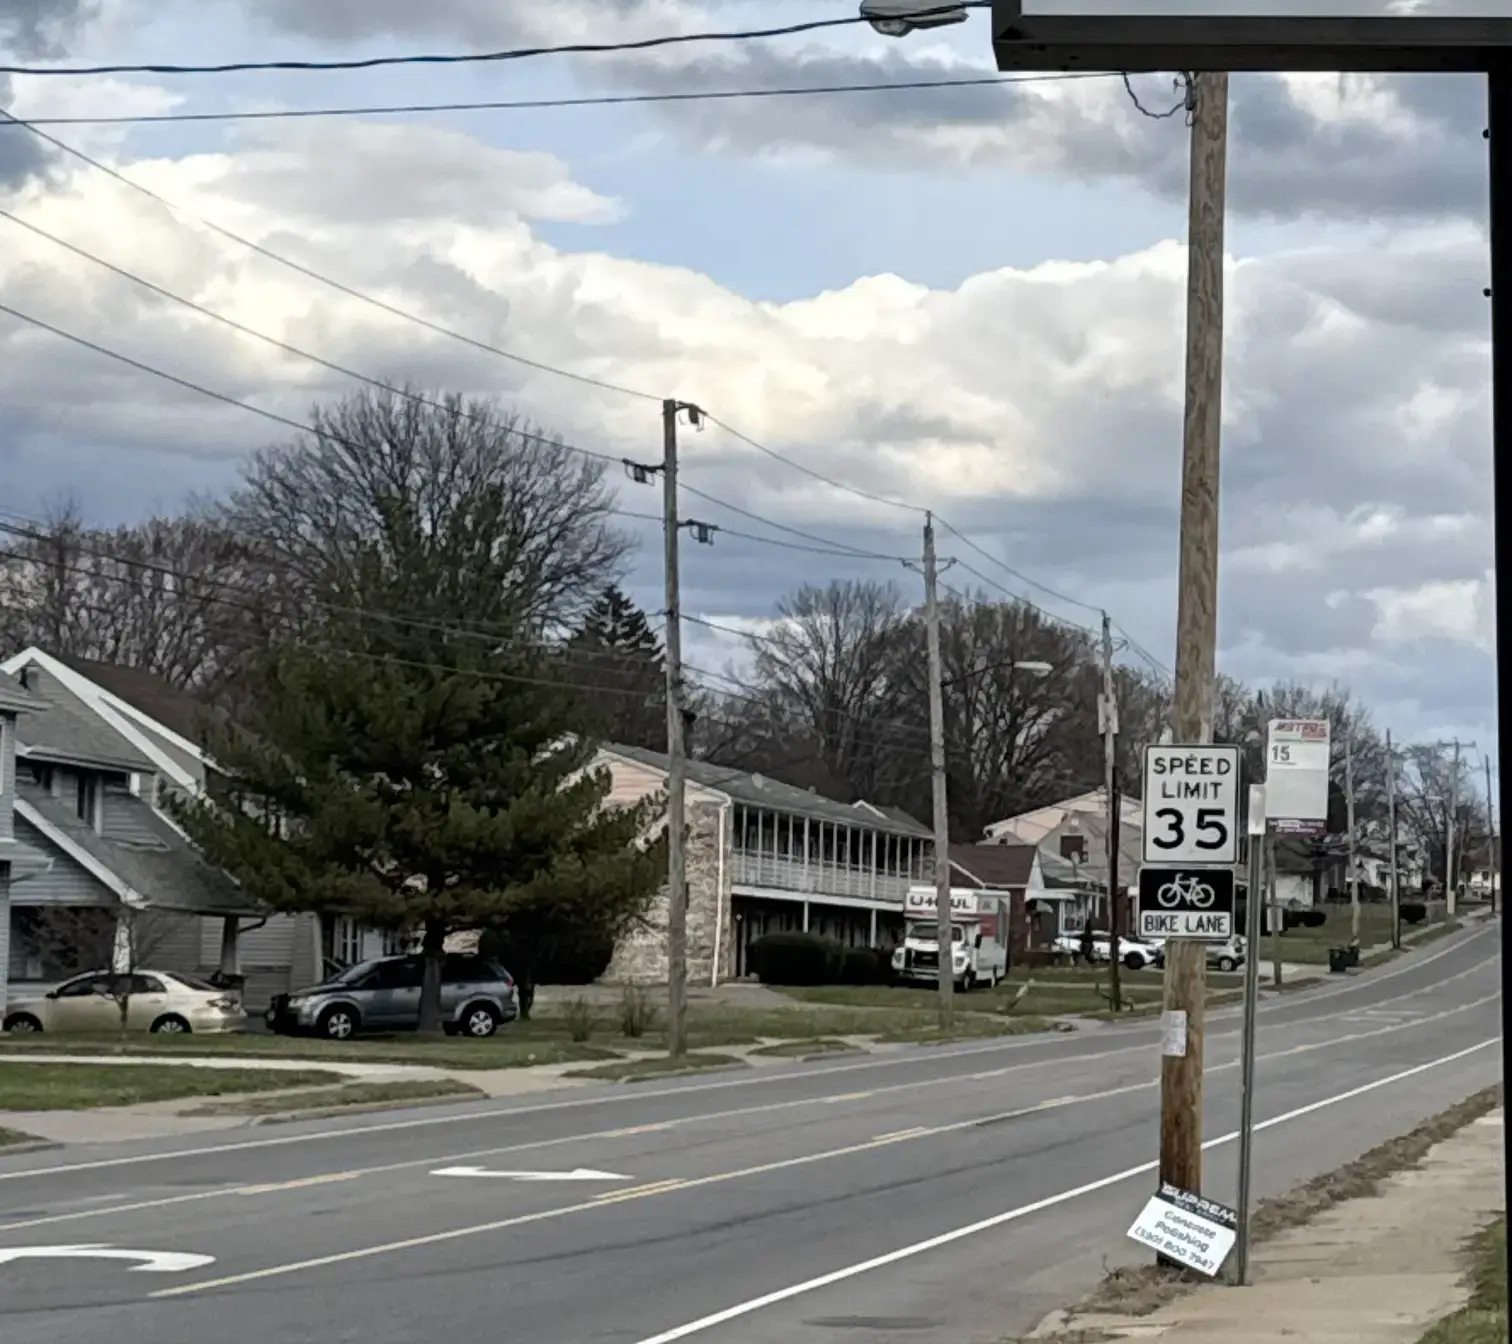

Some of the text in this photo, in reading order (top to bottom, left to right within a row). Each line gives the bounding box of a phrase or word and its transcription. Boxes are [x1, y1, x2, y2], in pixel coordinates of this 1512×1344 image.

[1271, 745, 1290, 762] 15
[1152, 757, 1232, 776] SPEED
[1161, 781, 1223, 800] LIMIT
[1151, 808, 1228, 850] 35
[909, 895, 972, 909] U-HUL
[1143, 914, 1227, 933] BIKE LANE
[1164, 1210, 1217, 1239] Concrete
[1155, 1220, 1210, 1253] Polishing
